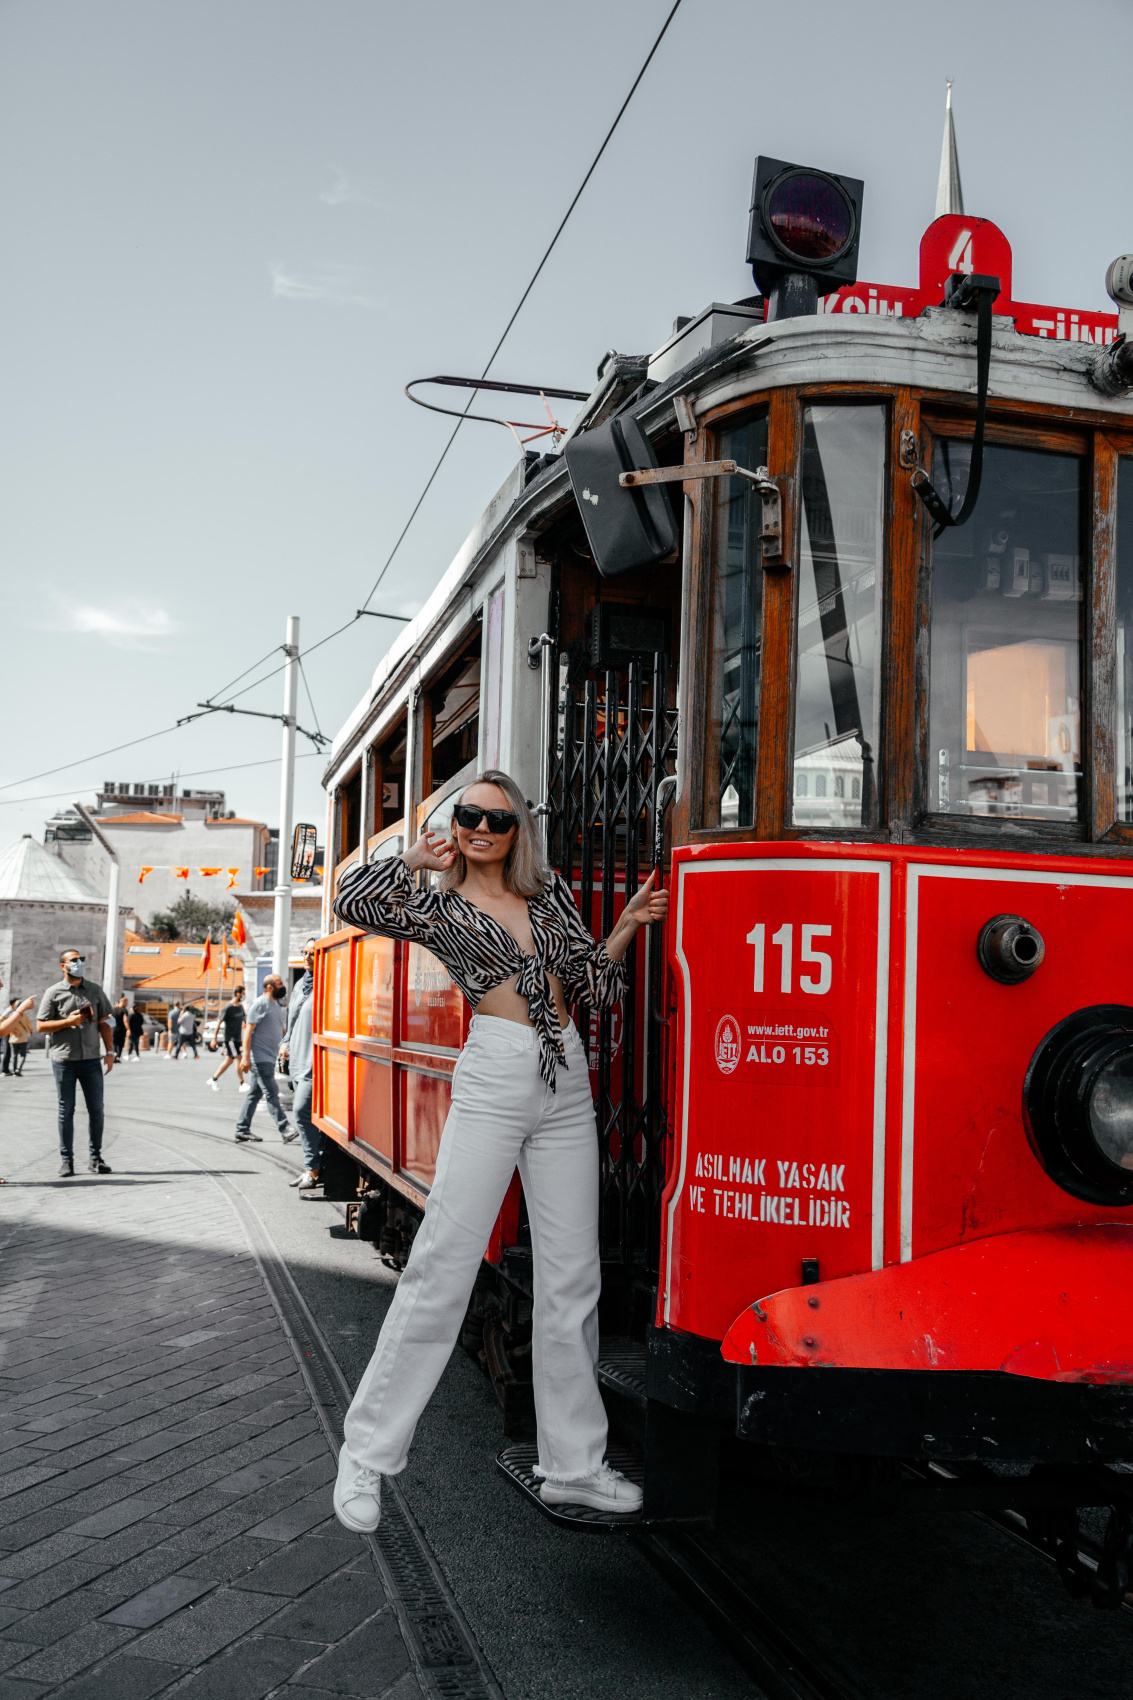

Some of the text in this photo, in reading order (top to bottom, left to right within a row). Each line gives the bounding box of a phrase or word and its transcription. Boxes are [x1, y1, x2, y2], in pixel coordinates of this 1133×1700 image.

[949, 230, 975, 275] 4
[746, 923, 832, 995] 115
[747, 1024, 829, 1039] www.iett.gov.tr
[746, 1045, 829, 1066] ALO 153
[695, 1152, 845, 1192] ASILMAK YASAK
[689, 1184, 850, 1228] VE TEHLİKELİDİR
